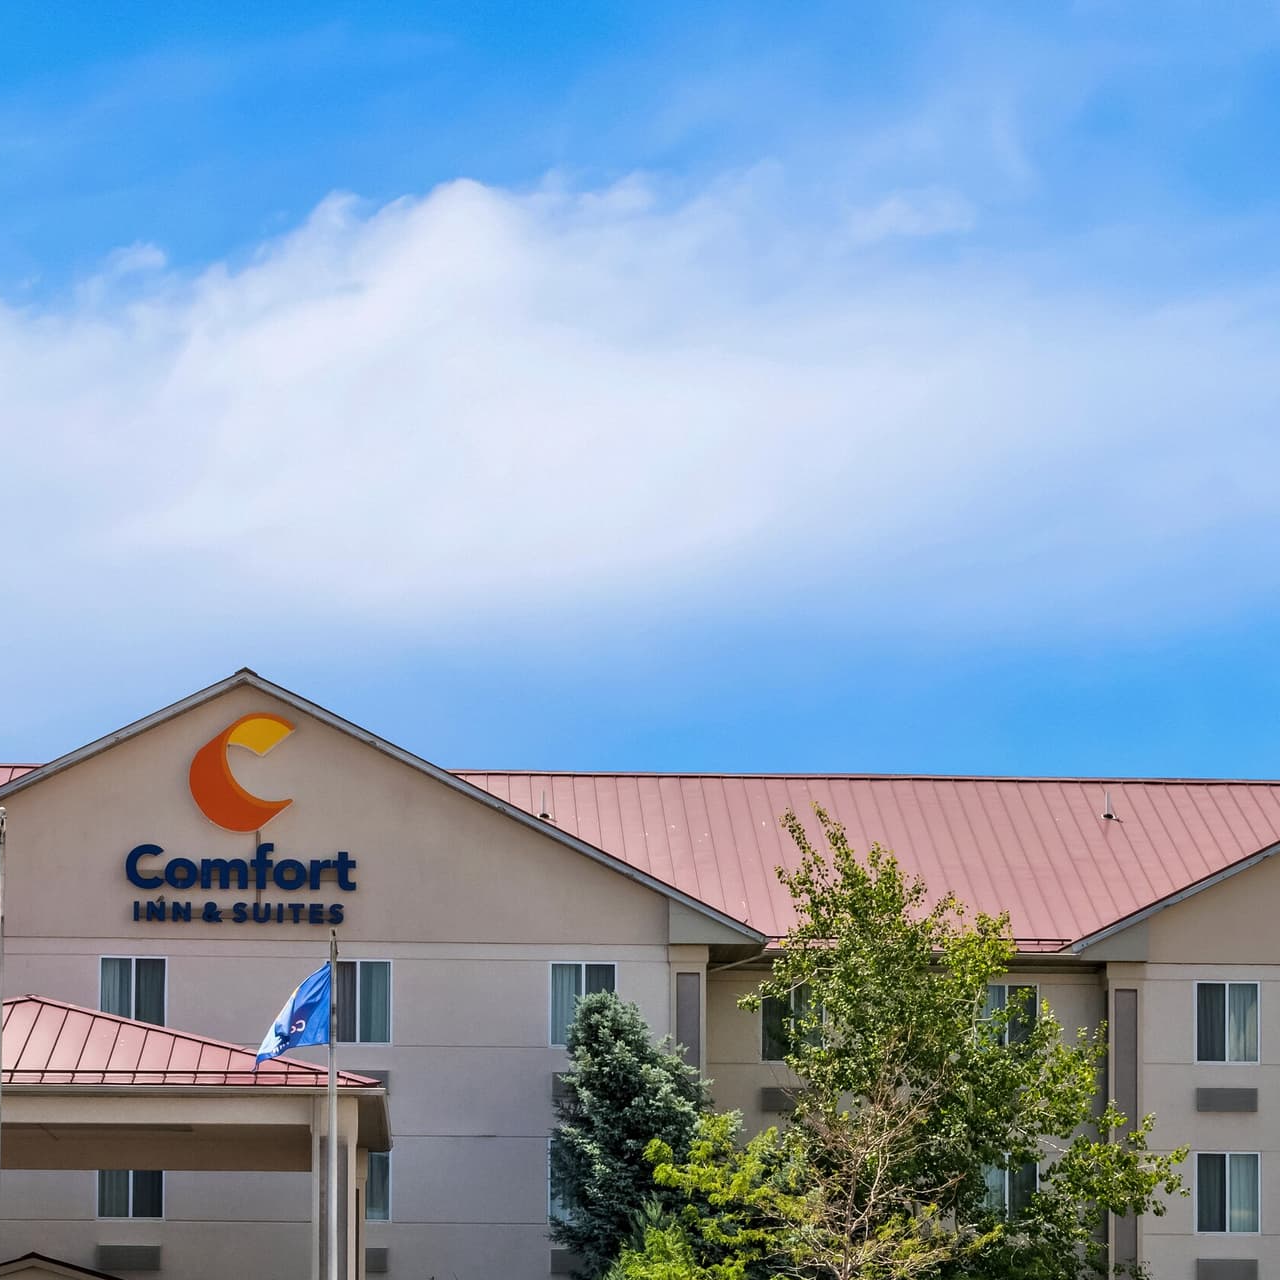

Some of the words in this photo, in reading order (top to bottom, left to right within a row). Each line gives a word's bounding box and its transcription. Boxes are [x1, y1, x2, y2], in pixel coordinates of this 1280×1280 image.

[125, 843, 357, 891] Comfort
[133, 901, 192, 922] INN
[202, 902, 223, 923] &
[232, 903, 345, 925] SUITES
